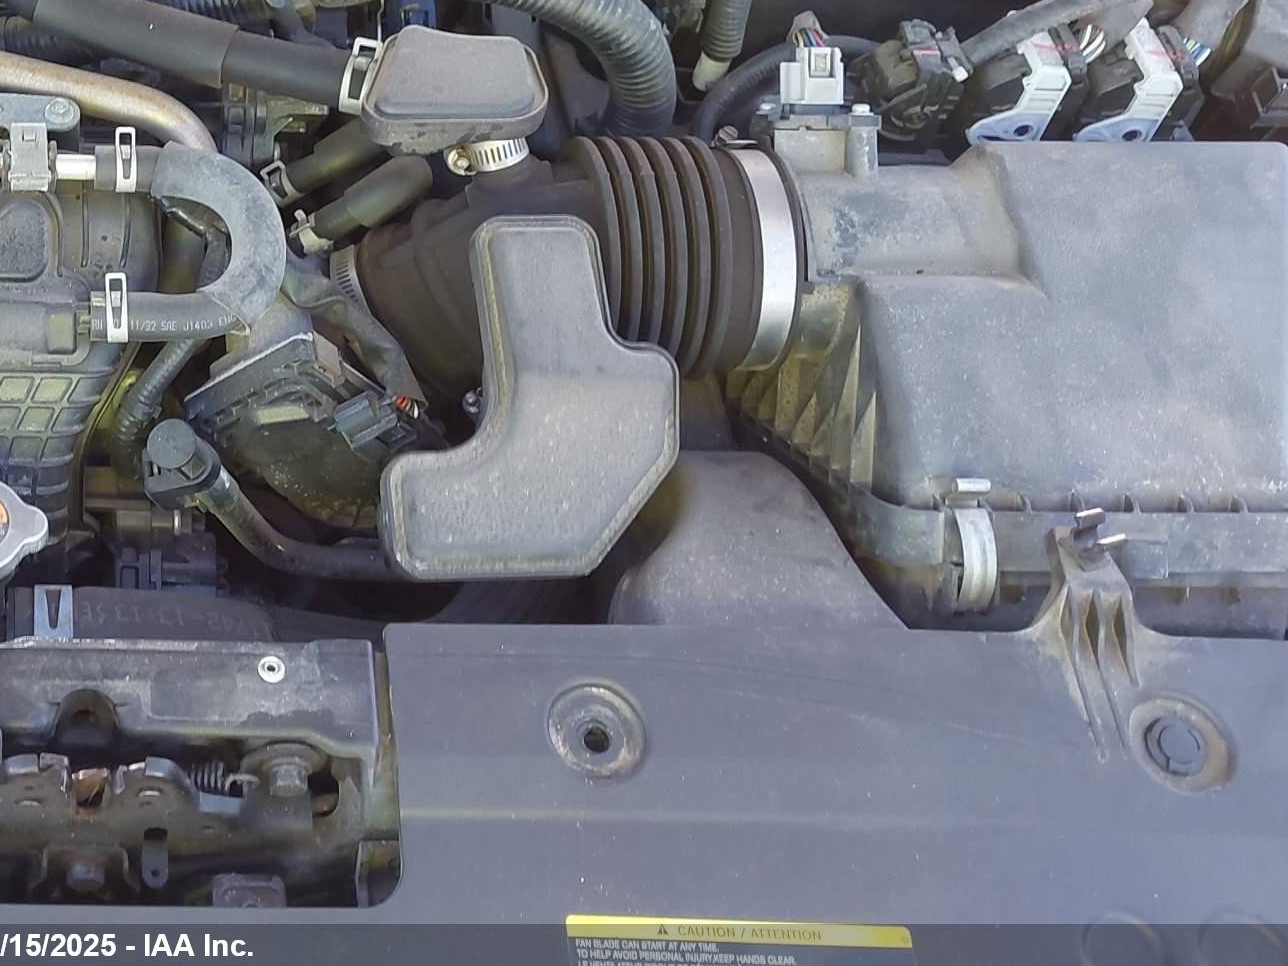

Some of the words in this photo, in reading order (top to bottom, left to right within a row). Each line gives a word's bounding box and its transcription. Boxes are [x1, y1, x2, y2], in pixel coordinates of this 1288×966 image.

[131, 319, 156, 331] 11/32
[161, 321, 177, 330] SAE
[678, 926, 735, 938] CAUTION
[751, 928, 822, 940] ATTENTION
[575, 938, 591, 948] FAN
[593, 938, 620, 949] BLADE
[622, 940, 640, 950] CAN
[641, 940, 667, 951] START
[668, 943, 678, 952] AT
[679, 943, 696, 952] ANY
[577, 948, 588, 958] TO
[590, 949, 611, 959] HELP
[613, 950, 638, 960] AVOID
[639, 951, 682, 962] PERSONAL
[736, 954, 766, 964] HANDS
